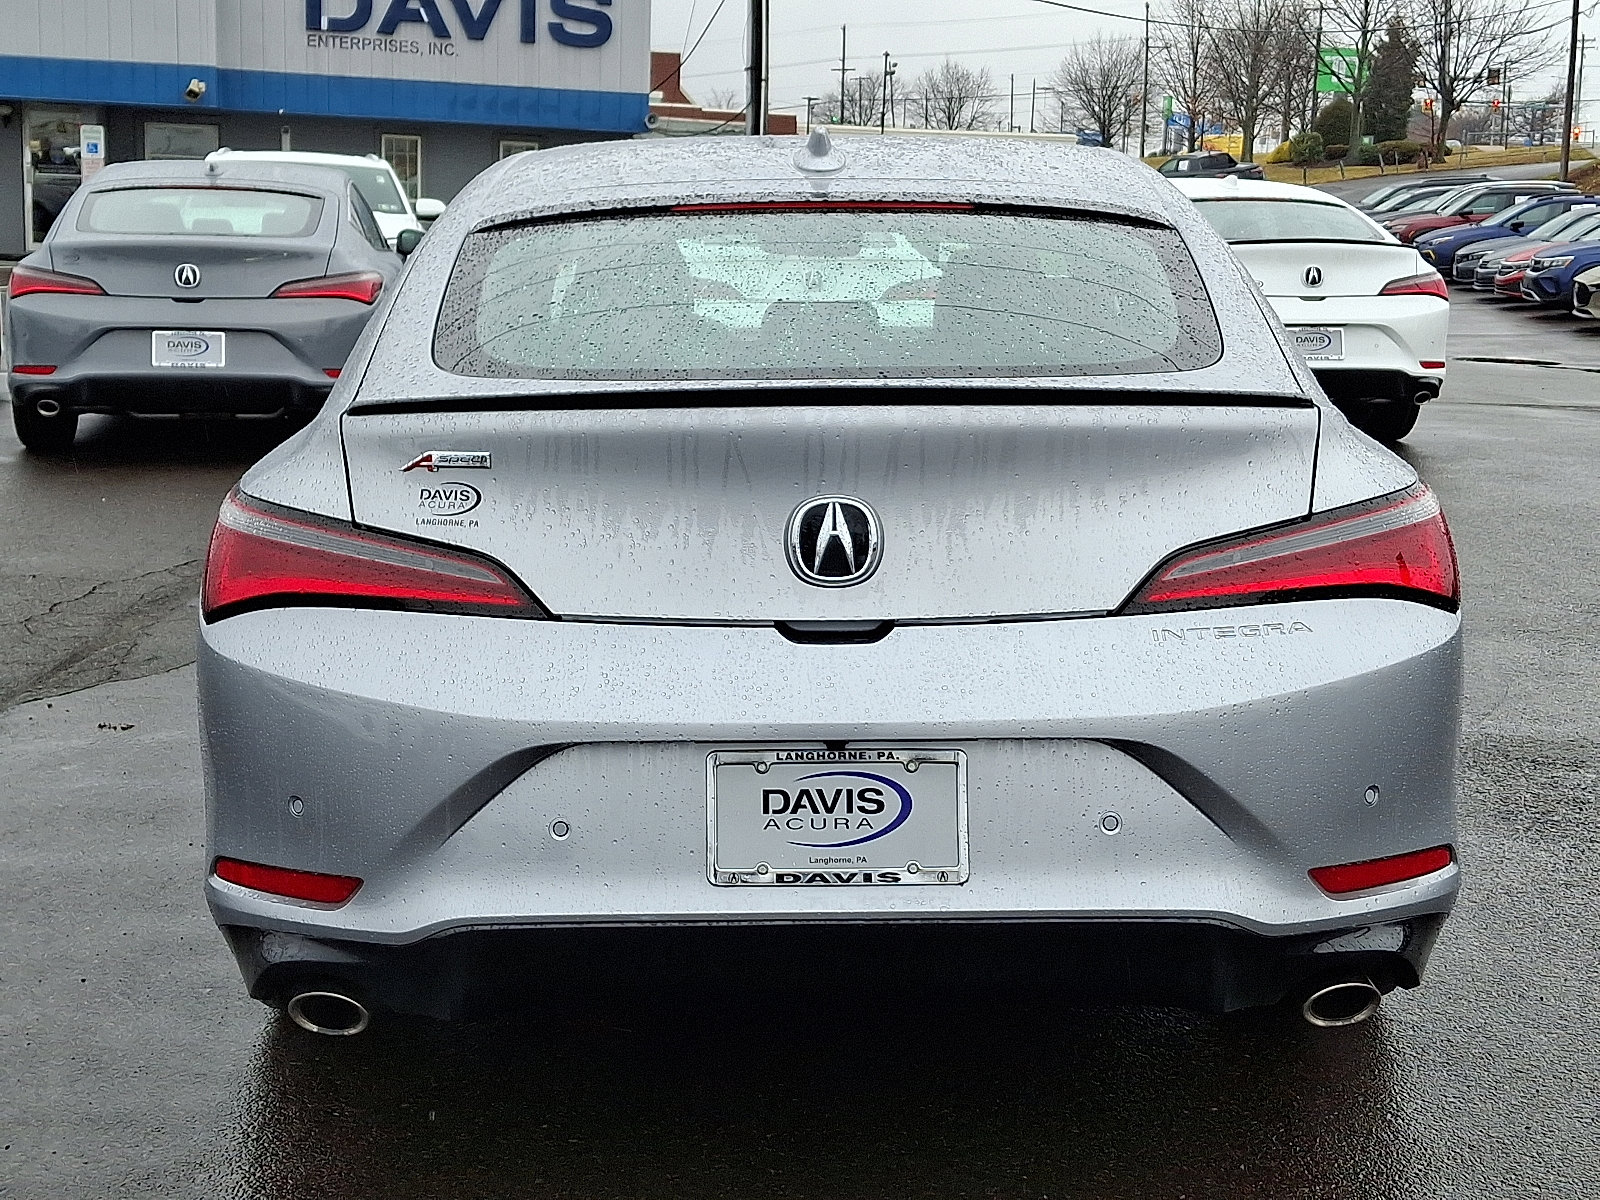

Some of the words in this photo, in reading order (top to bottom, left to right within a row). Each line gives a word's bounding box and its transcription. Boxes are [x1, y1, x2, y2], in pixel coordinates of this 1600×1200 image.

[305, 0, 613, 48] DAVIS
[306, 34, 424, 56] ENTERPRISES,
[427, 42, 460, 57] INC.
[167, 340, 202, 349] DAVIS
[1295, 336, 1326, 344] DAVIS
[419, 488, 471, 502] DAVIS
[418, 500, 467, 510] ACURA
[415, 517, 467, 528] LANGHORNE,
[468, 519, 479, 528] PA
[1151, 621, 1314, 642] INTEGRA
[776, 751, 873, 761] LANGHORNE,
[876, 751, 901, 761] PA.
[762, 787, 886, 815] DAVIS
[763, 817, 875, 831] ACURA
[809, 856, 855, 865] Langhorne,
[856, 856, 868, 864] PA
[775, 872, 902, 885] DAVIS
